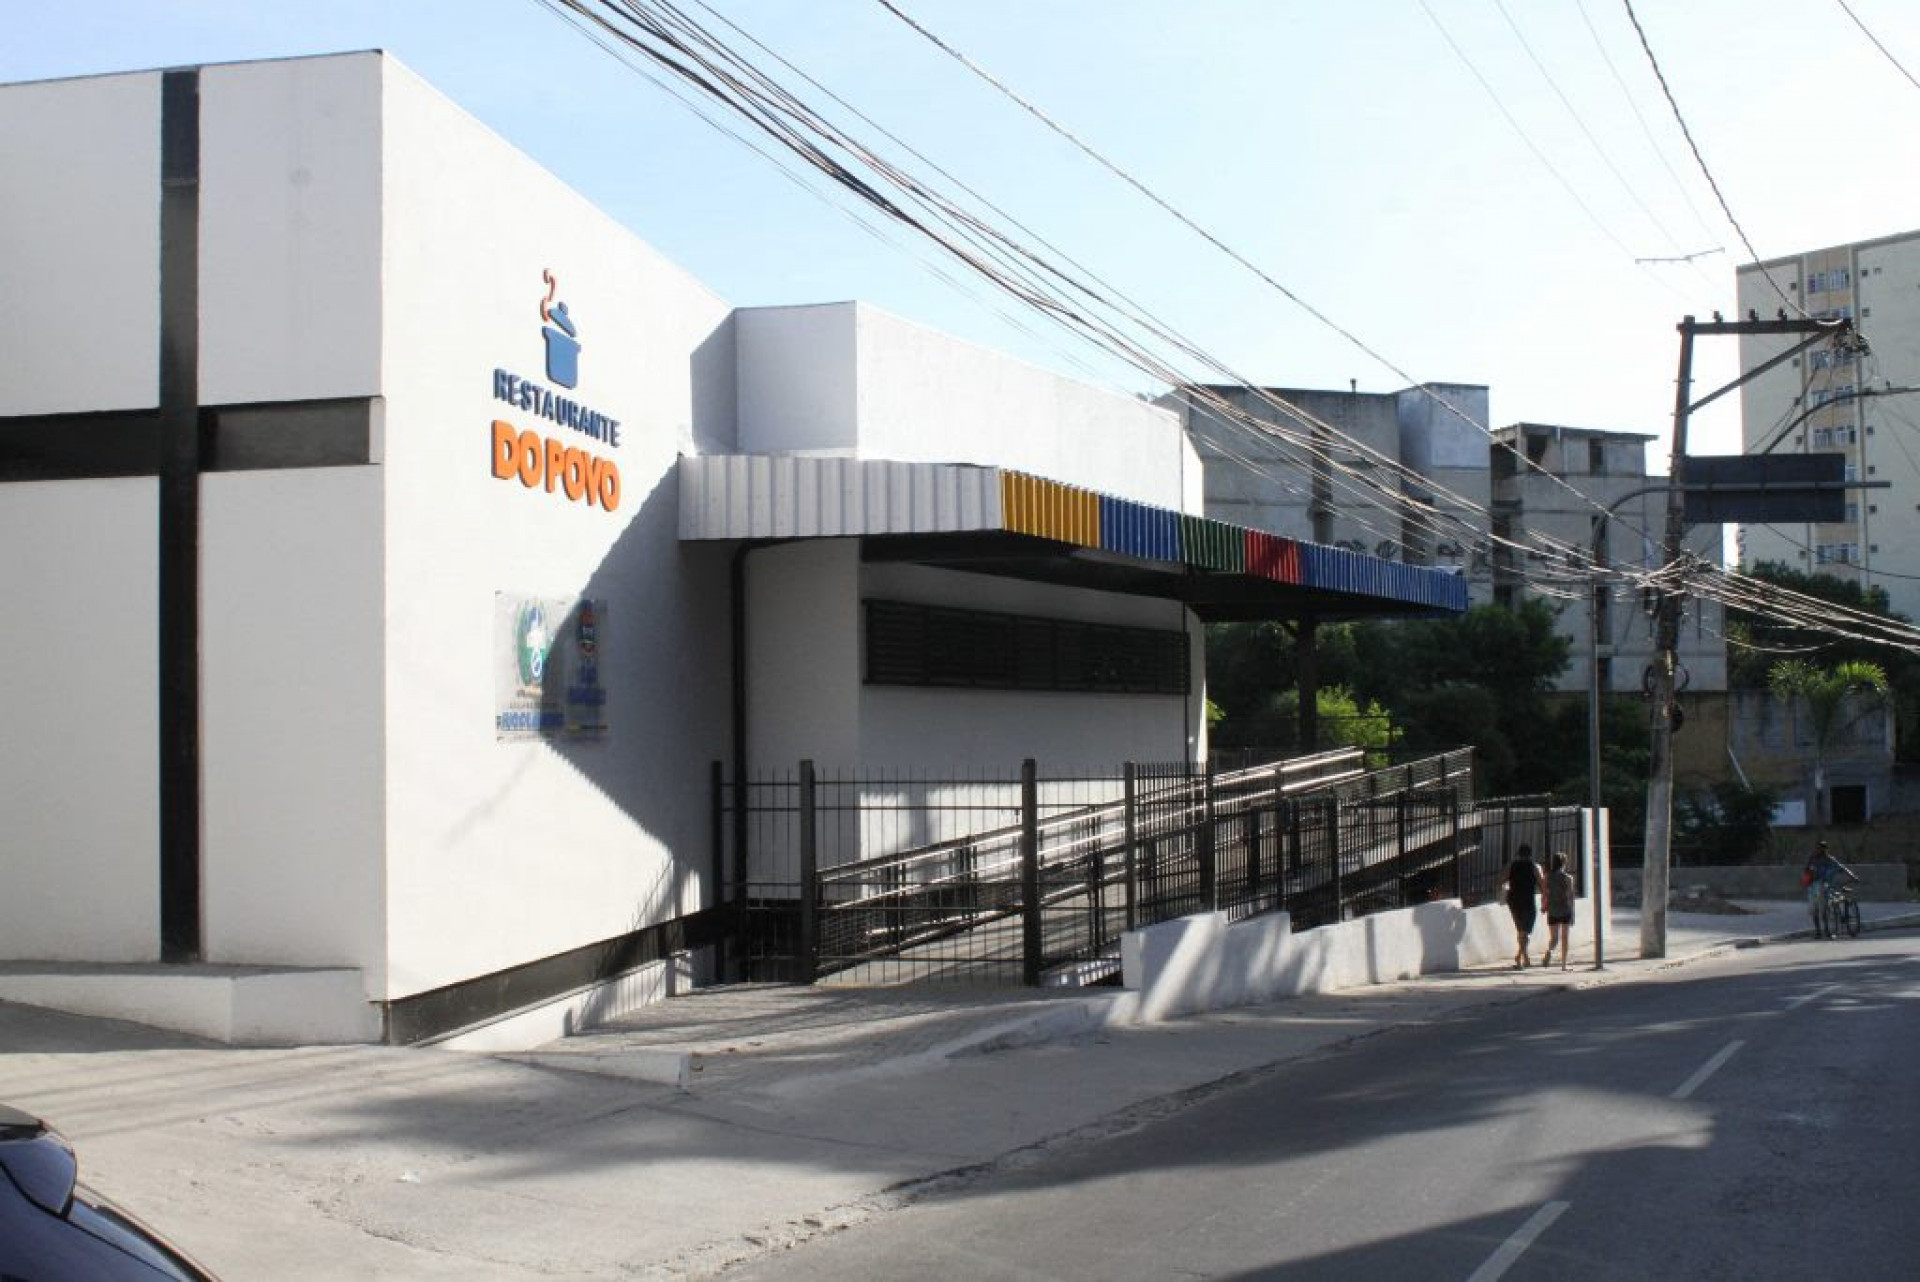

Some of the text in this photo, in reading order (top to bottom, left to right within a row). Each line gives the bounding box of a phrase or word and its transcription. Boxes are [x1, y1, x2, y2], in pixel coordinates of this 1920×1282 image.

[494, 368, 620, 447] RESTAURANTE
[492, 420, 620, 512] DO POVO
